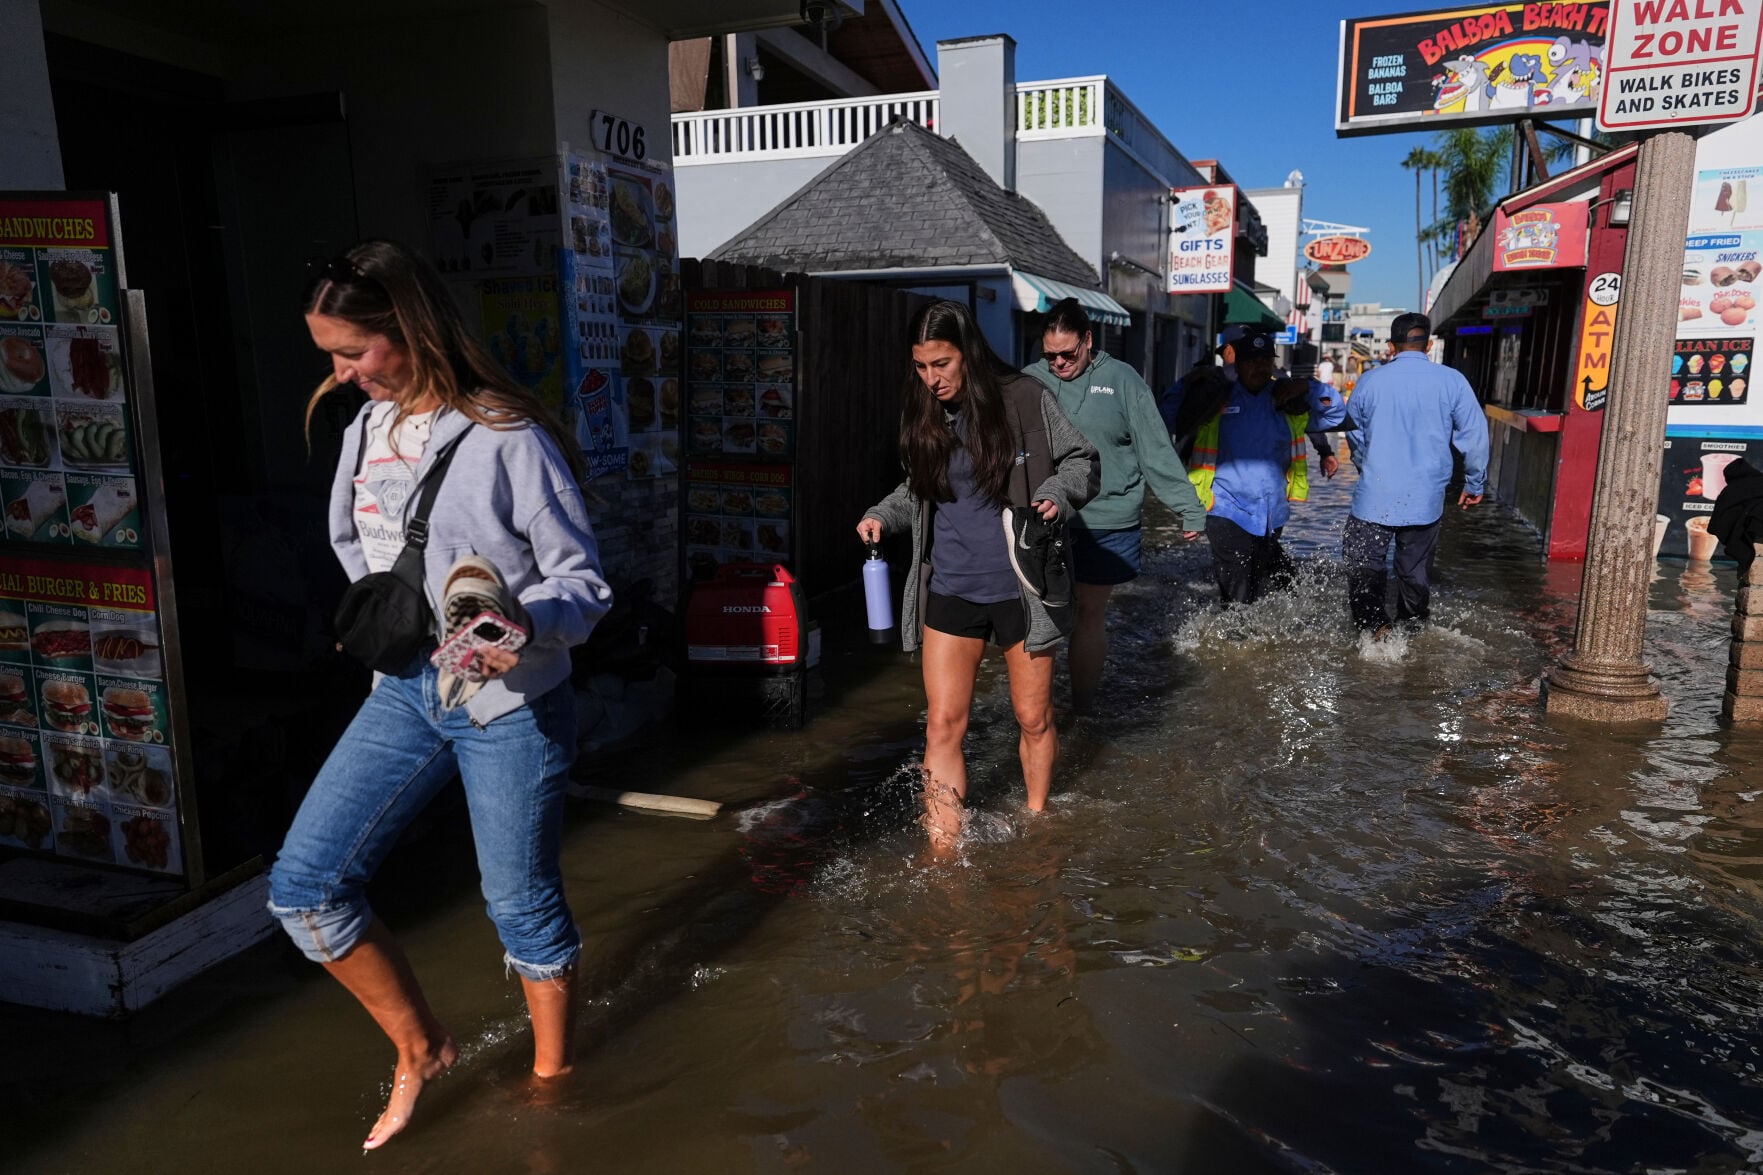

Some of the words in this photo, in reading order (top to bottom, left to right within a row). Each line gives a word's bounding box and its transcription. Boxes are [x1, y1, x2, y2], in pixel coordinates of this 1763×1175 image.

[1633, 0, 1745, 26] WALK
[1417, 9, 1513, 66] BALBOA
[1523, 3, 1590, 32] BEACH
[1631, 24, 1739, 59] ZONE
[1372, 54, 1404, 67] FROZEN
[1368, 66, 1407, 80] BANANAS
[1368, 81, 1404, 95] BALBOA
[1620, 74, 1675, 94] WALK
[1681, 68, 1741, 88] BIKES
[1373, 93, 1398, 107] BARS
[1615, 97, 1655, 114] AND
[1661, 89, 1740, 110] SKATES
[603, 114, 645, 160] 706
[1180, 202, 1197, 215] PICK
[1180, 239, 1224, 252] GIFTS
[1710, 237, 1740, 247] FRIED
[1173, 255, 1202, 271] BEACH
[1205, 253, 1229, 270] GEAR
[1716, 251, 1757, 263] SNICKERS
[1172, 271, 1229, 285] SUNGLASSES
[1595, 277, 1619, 292] 24
[694, 299, 720, 310] COLD
[722, 298, 787, 309] SANDWICHES
[1584, 310, 1612, 369] ATM
[1675, 341, 1719, 353] LIAN
[1721, 340, 1752, 351] ICE
[0, 573, 25, 593] IAL
[27, 575, 86, 599] BURGER
[89, 581, 100, 600] &
[103, 582, 147, 604] FRIES
[28, 602, 45, 613] Chili
[46, 604, 71, 616] Cheese
[72, 607, 88, 620] Dog
[721, 605, 772, 613] HONDA
[91, 610, 109, 620] Corn
[110, 611, 125, 624] Dog
[62, 672, 86, 685] Burger
[138, 682, 158, 694] Burger
[105, 742, 126, 754] Onion
